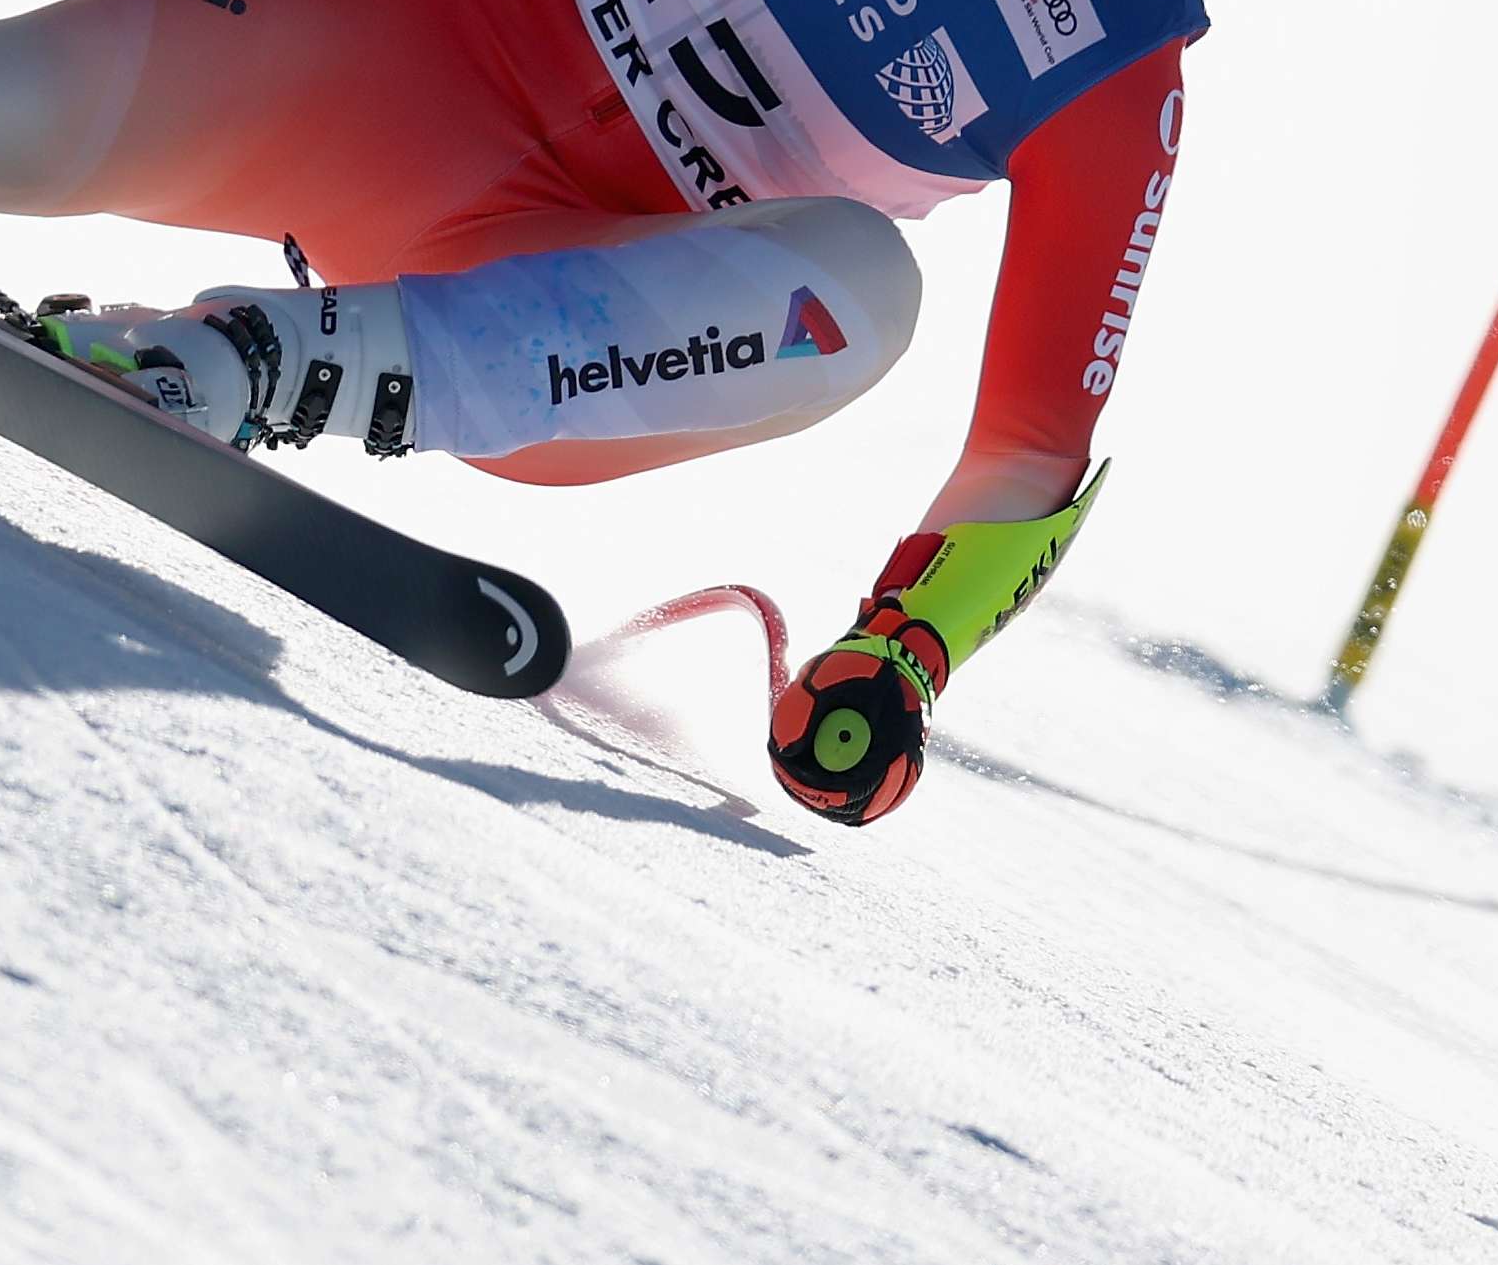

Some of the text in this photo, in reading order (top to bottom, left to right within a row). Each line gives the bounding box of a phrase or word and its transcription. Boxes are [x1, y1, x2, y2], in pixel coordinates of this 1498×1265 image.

[656, 98, 753, 210] CRE
[321, 287, 338, 336] EAD
[1082, 169, 1172, 396] sunrise
[547, 326, 765, 406] helvetia
